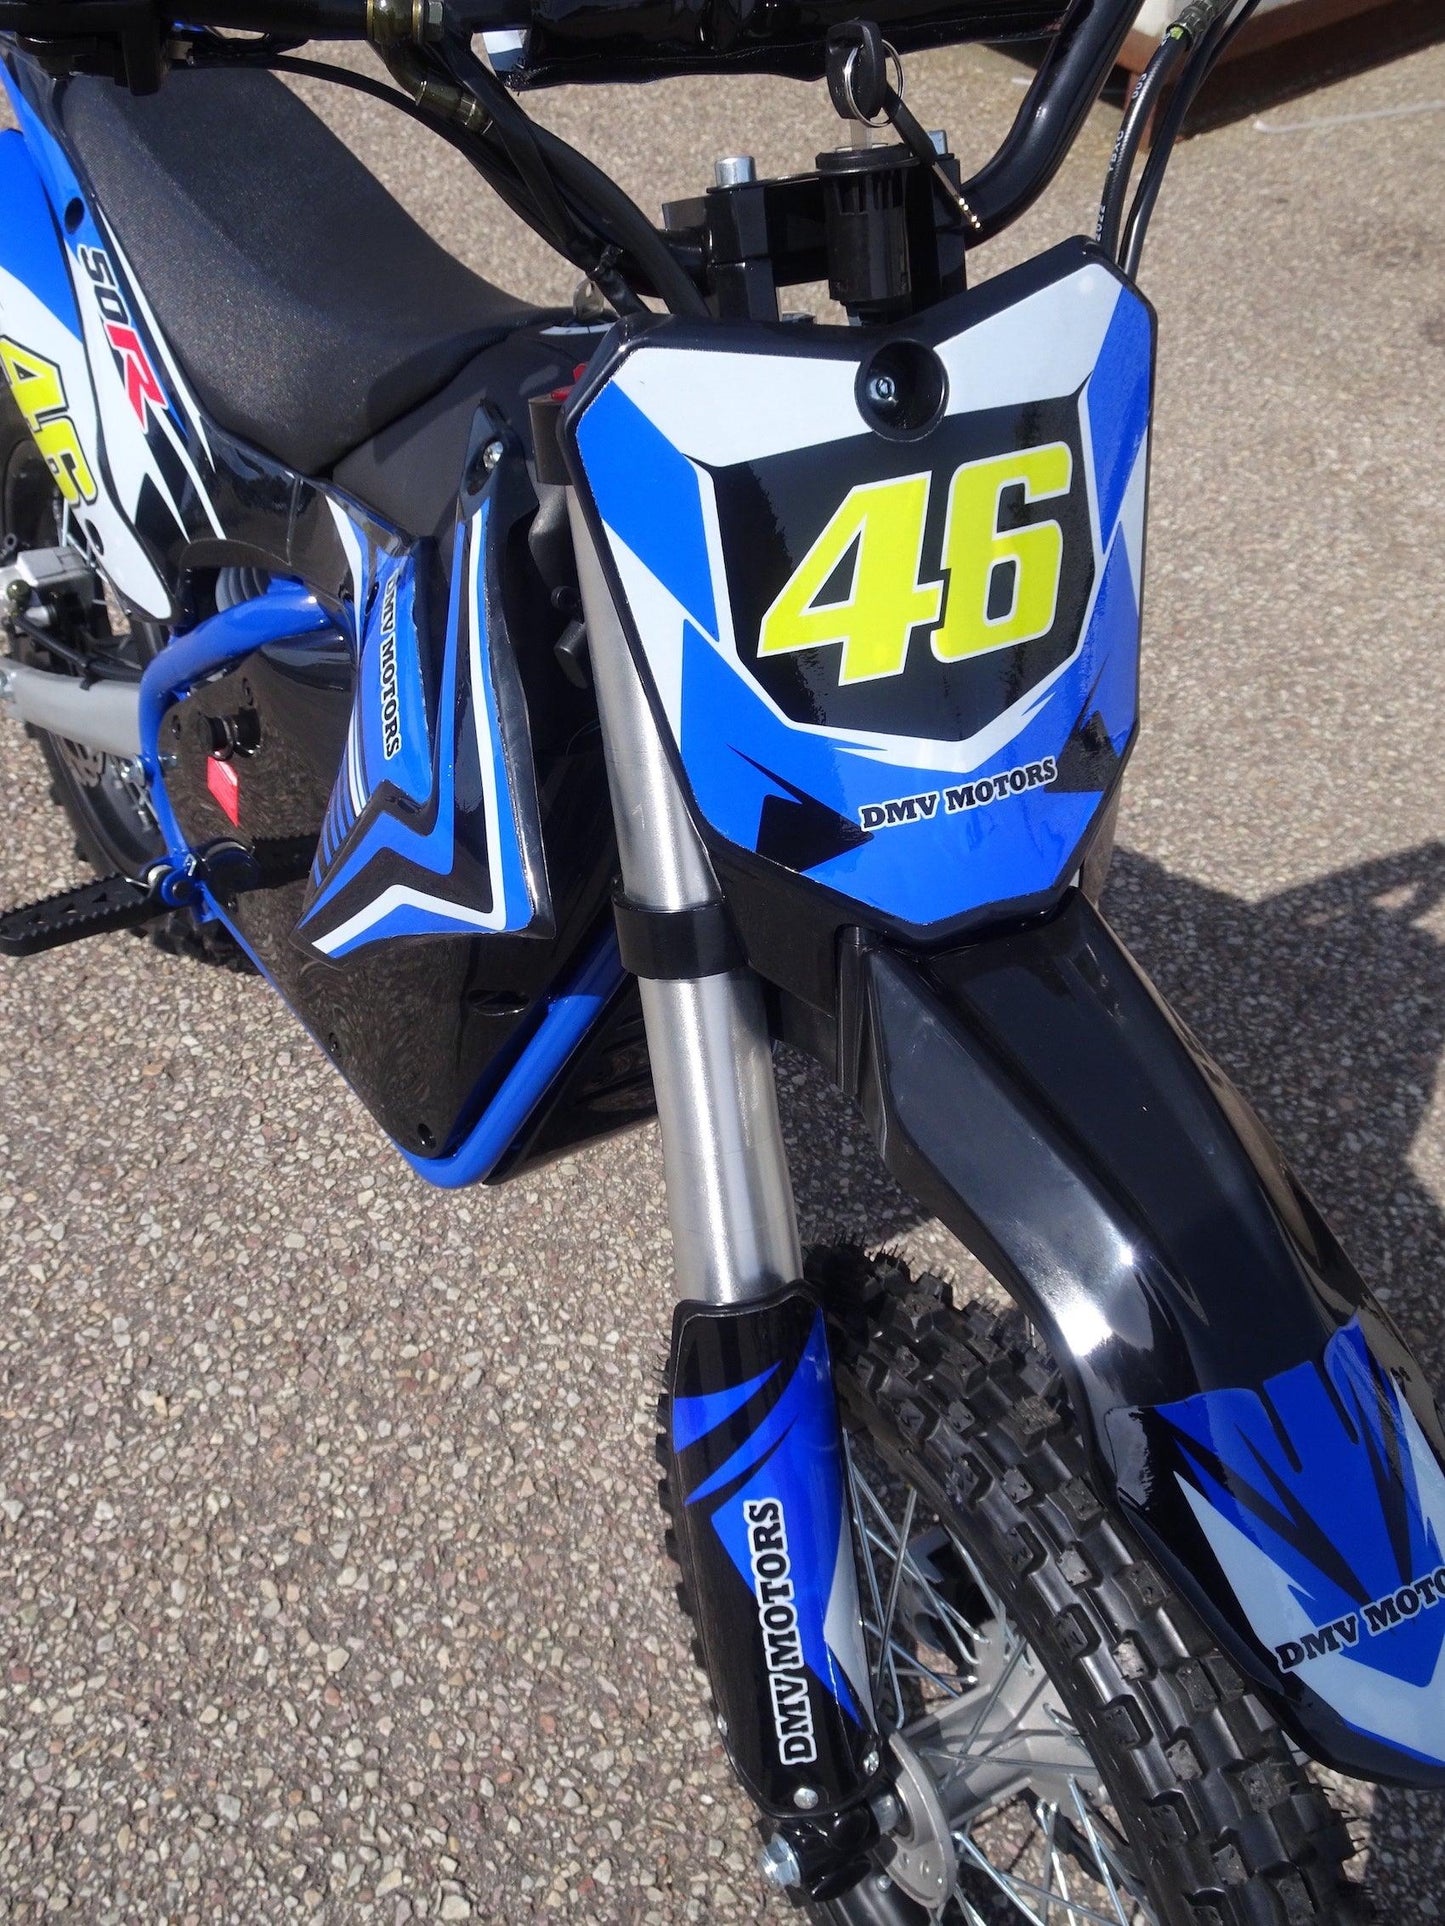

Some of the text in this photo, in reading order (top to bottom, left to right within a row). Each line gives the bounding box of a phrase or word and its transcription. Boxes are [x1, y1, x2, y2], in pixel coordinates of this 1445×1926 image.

[757, 441, 1073, 687] 46
[380, 569, 400, 759] DMV MOTORS
[860, 757, 1057, 830] DMV MOTORS
[745, 1499, 815, 1763] DMV MOTORS
[1274, 1614, 1358, 1671] DMV
